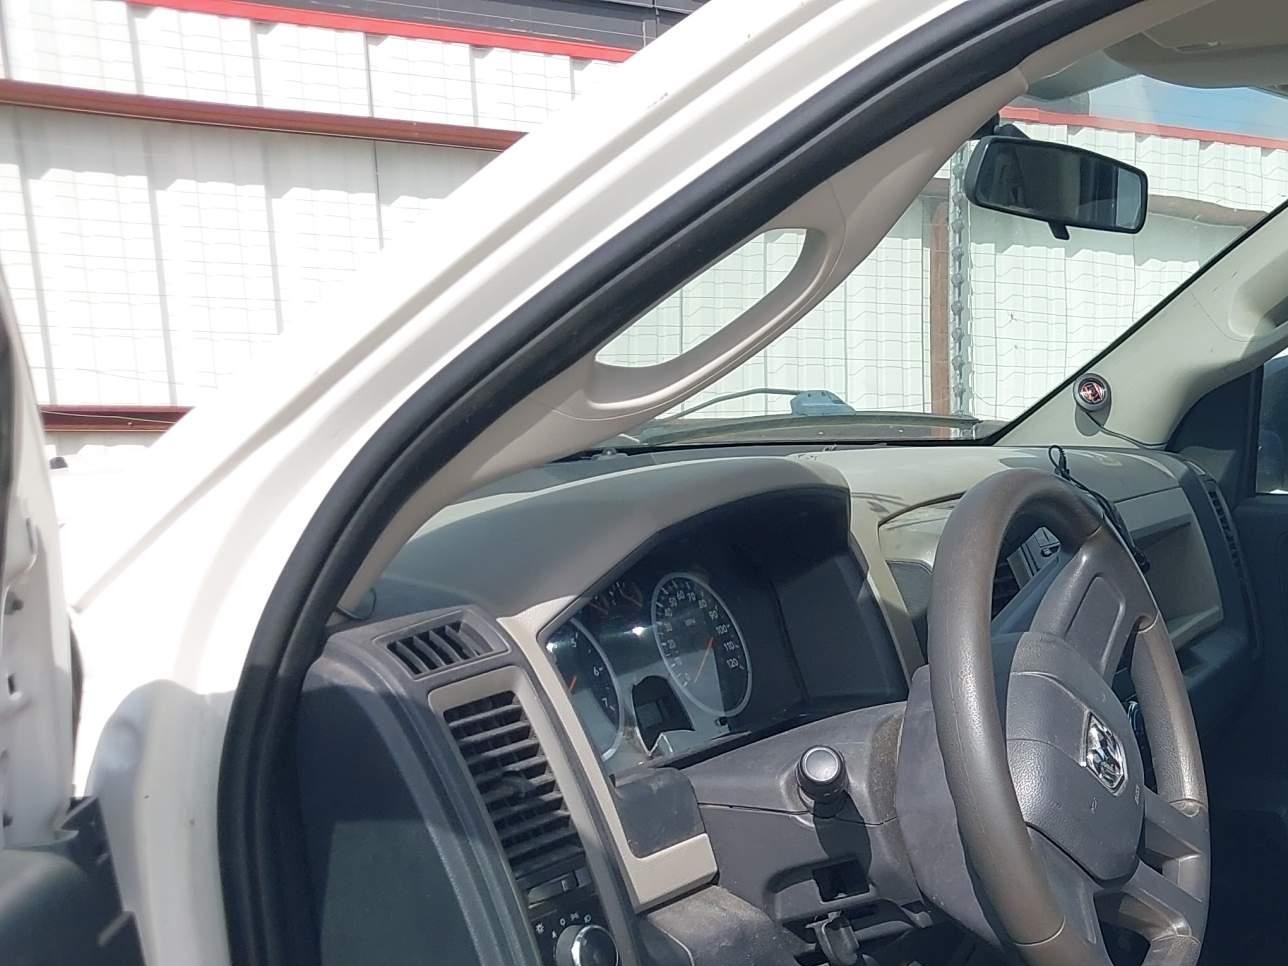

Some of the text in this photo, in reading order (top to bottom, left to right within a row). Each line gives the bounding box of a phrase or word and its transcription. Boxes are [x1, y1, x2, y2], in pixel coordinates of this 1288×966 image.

[687, 592, 696, 602] 70
[708, 610, 718, 620] 90
[715, 624, 728, 635] 100
[726, 658, 739, 669] 120
